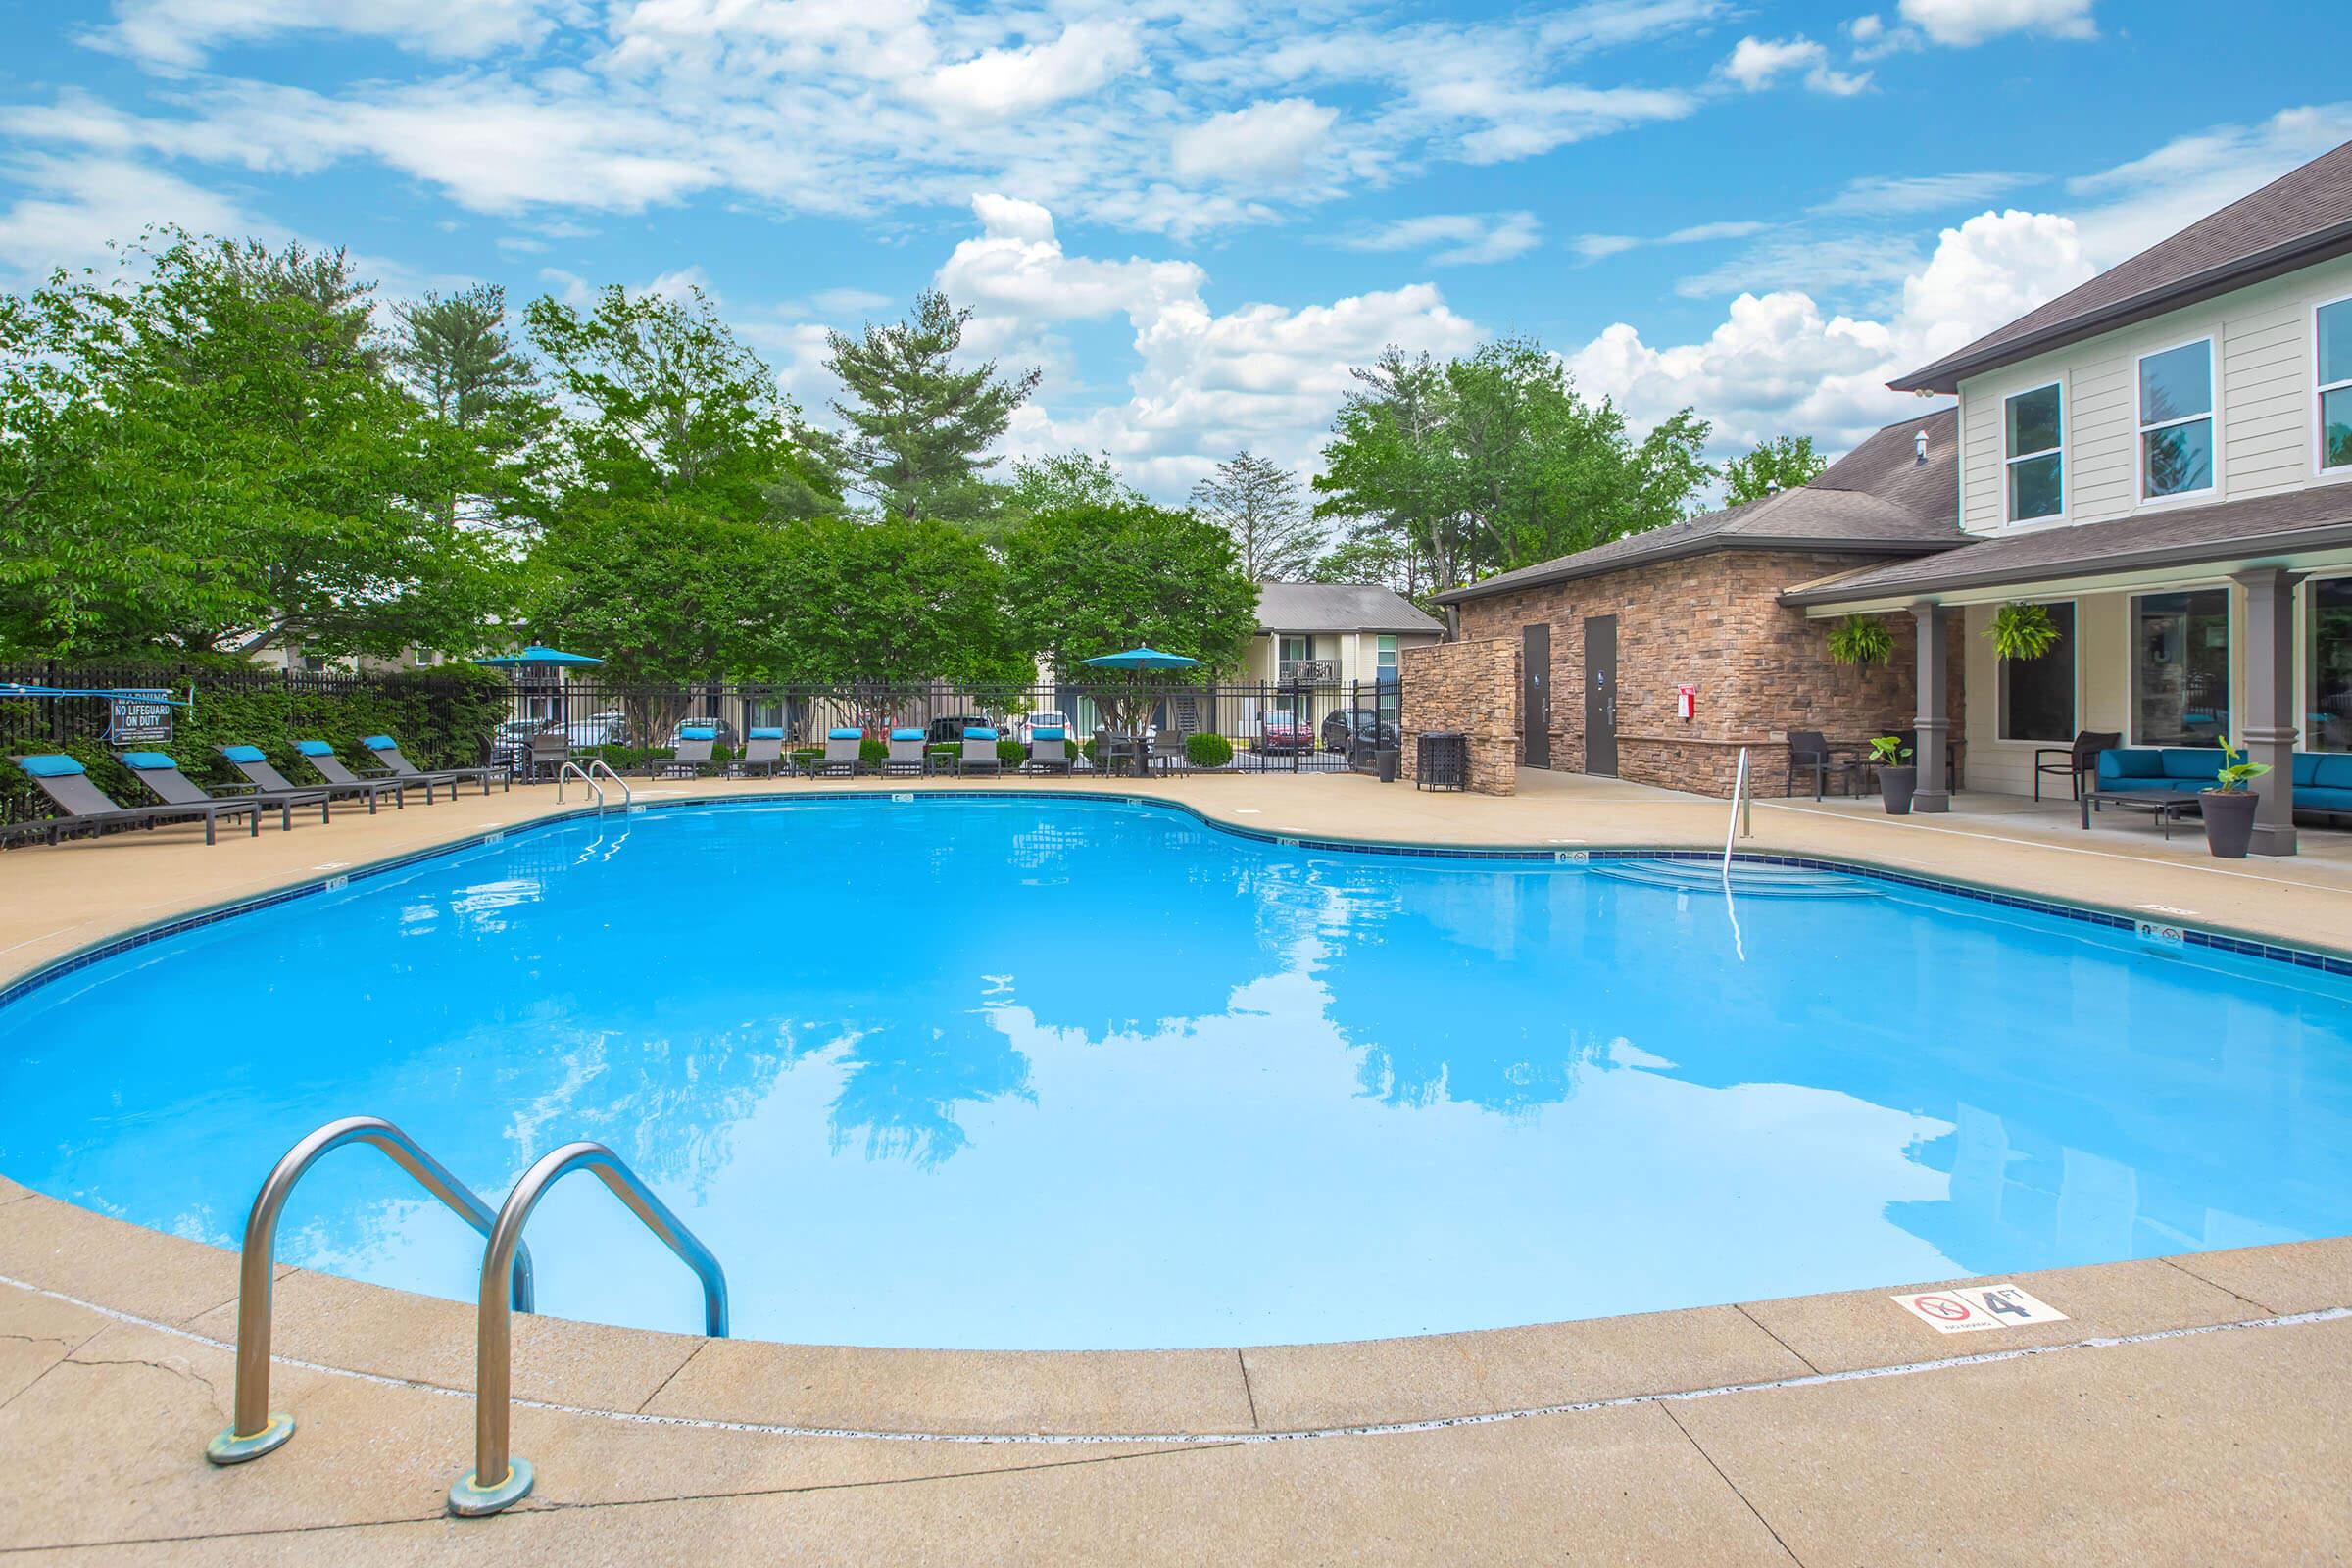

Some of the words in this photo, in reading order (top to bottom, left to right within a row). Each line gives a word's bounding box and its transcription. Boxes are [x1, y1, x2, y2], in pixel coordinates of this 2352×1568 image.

[115, 705, 126, 716] NO
[128, 705, 170, 715] LIFEGUARD
[126, 716, 138, 727] ON
[139, 715, 160, 726] DUTY
[1998, 1289, 2024, 1300] FT
[1982, 1292, 2032, 1318] 4
